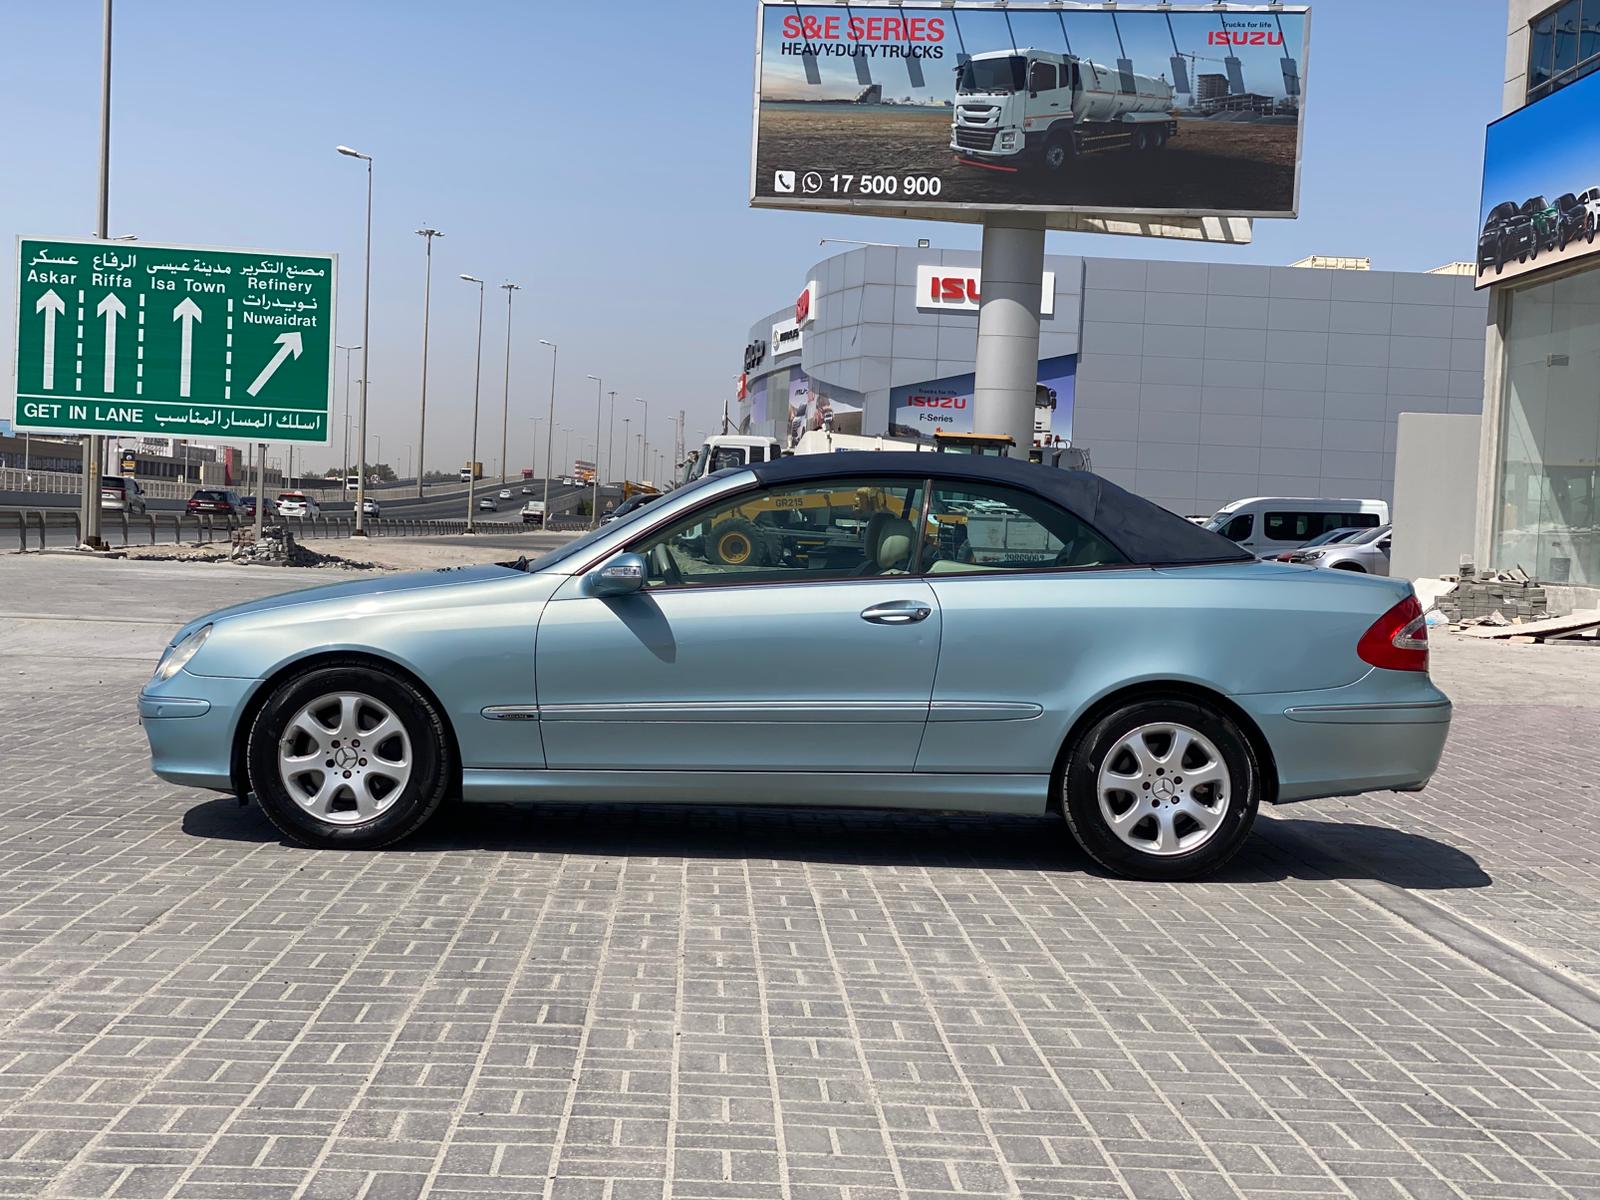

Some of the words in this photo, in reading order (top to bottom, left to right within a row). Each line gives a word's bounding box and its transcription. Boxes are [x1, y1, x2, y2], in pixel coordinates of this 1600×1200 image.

[782, 15, 840, 39] S&E
[847, 16, 945, 42] SERIES
[1207, 31, 1284, 46] ISUZU
[781, 42, 880, 58] HEAVY-DUTY
[881, 44, 944, 59] TRUCKS
[830, 174, 853, 193] 17
[859, 175, 897, 195] 500
[903, 176, 941, 196] 900
[28, 249, 79, 266] عسكر
[93, 252, 136, 271] الرفاع
[146, 261, 190, 274] عيسى
[193, 259, 232, 277] مدينة
[239, 261, 284, 276] التكرير
[286, 265, 325, 279] مصنع
[27, 270, 77, 285] Askar
[92, 273, 132, 288] Riffa
[151, 277, 176, 290] Isa
[184, 279, 226, 293] Town
[248, 277, 312, 294] Refinery
[931, 277, 981, 303] ISU
[242, 294, 318, 311] نويدرات
[243, 312, 317, 327] Nuwaidrat
[908, 396, 966, 409] ISUZU
[24, 403, 61, 419] GET
[69, 405, 87, 420] IN
[95, 406, 144, 423] LANE
[154, 408, 221, 427] المناسب
[221, 410, 272, 429] المسار
[275, 413, 320, 430] اسلك
[919, 413, 953, 423] F-Series
[776, 498, 803, 507] GR215
